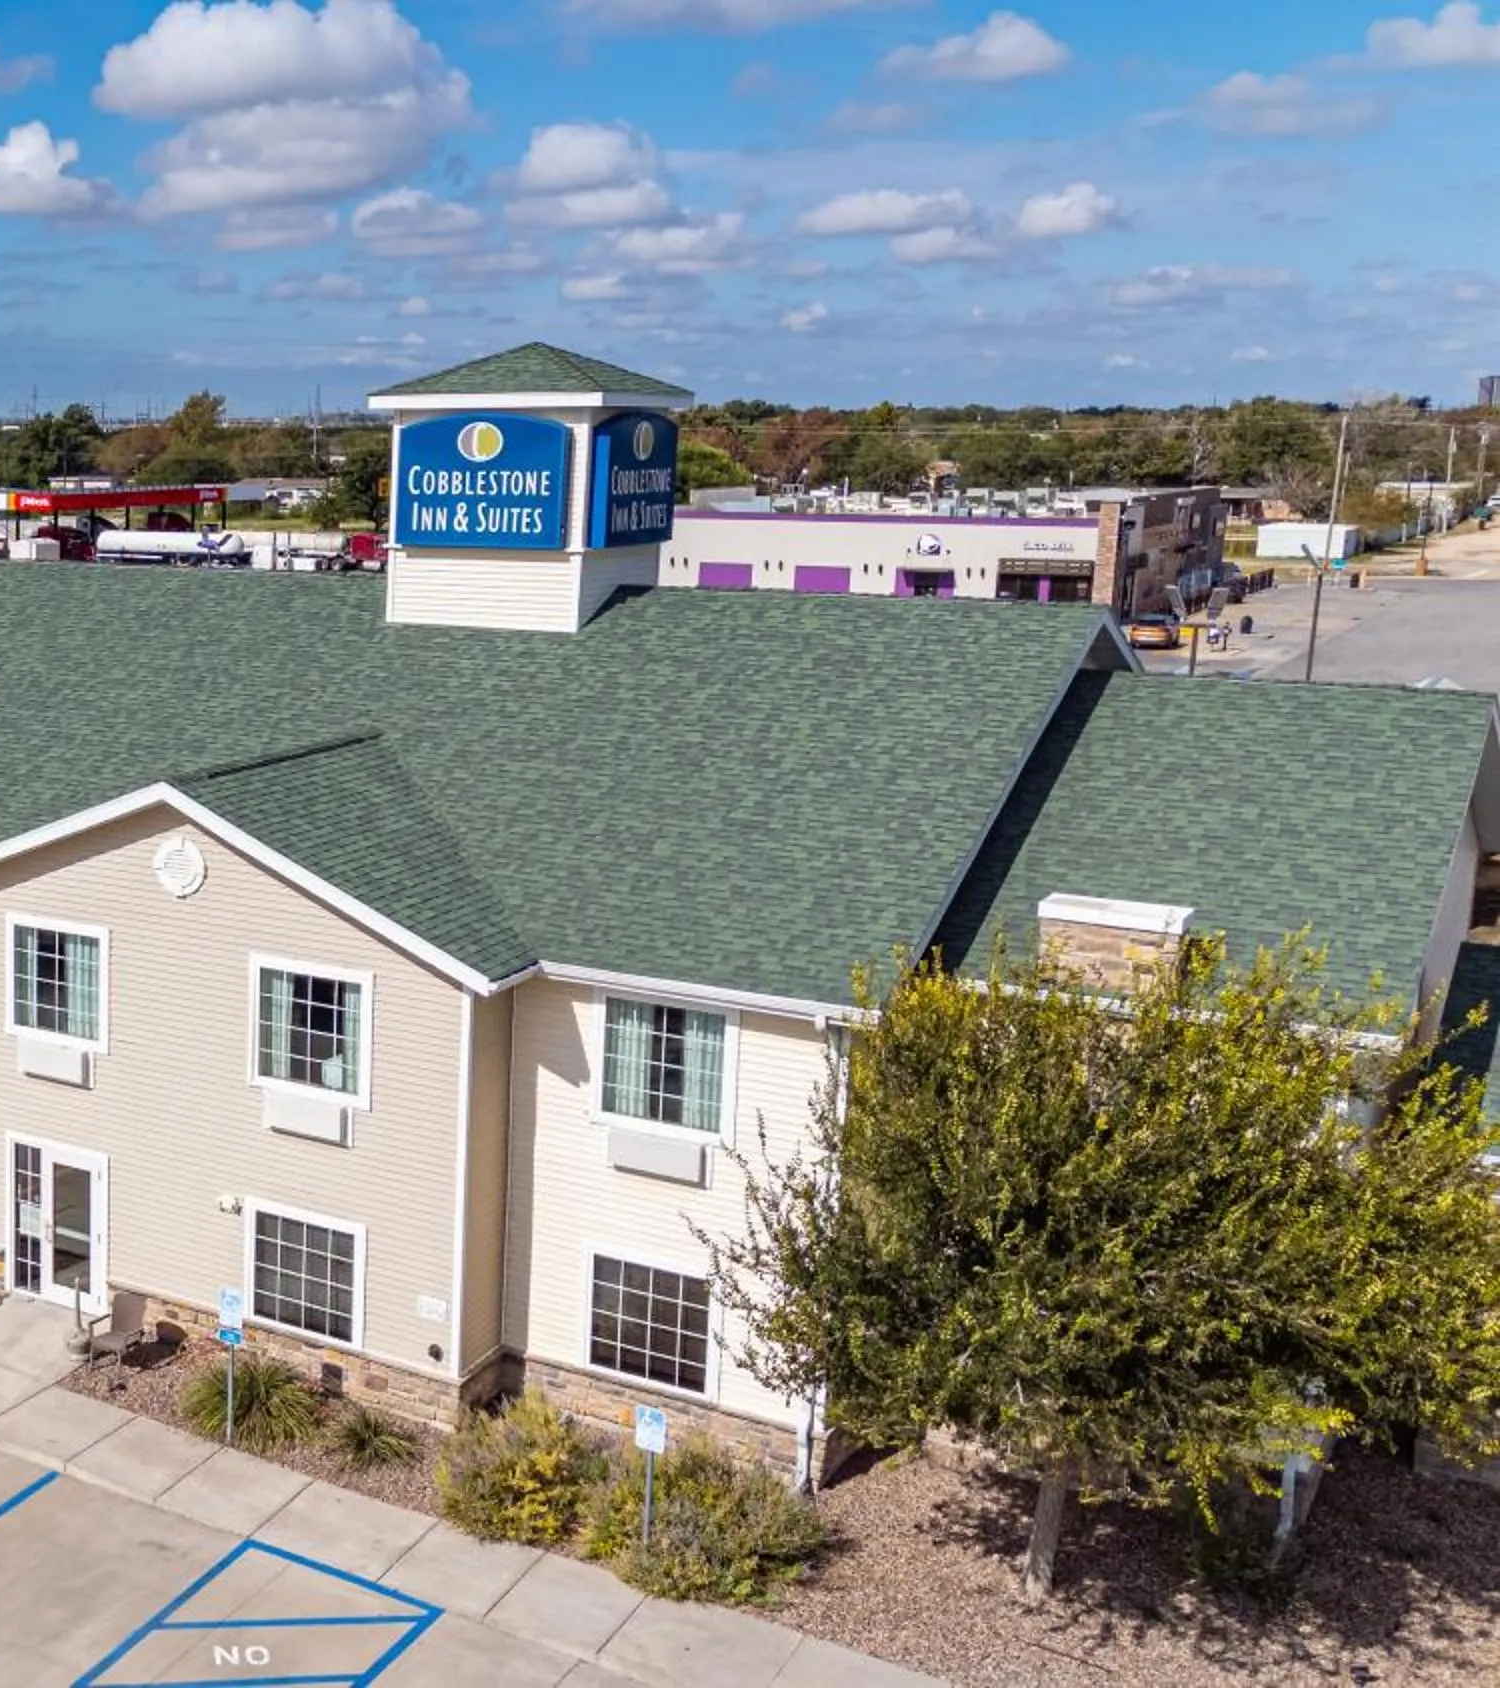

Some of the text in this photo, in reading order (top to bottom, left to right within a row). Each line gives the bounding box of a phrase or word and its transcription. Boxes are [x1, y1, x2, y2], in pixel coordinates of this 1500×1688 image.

[408, 465, 551, 496] COBBLESTONE
[412, 502, 543, 533] INN & SUITES
[213, 1645, 271, 1665] NO
